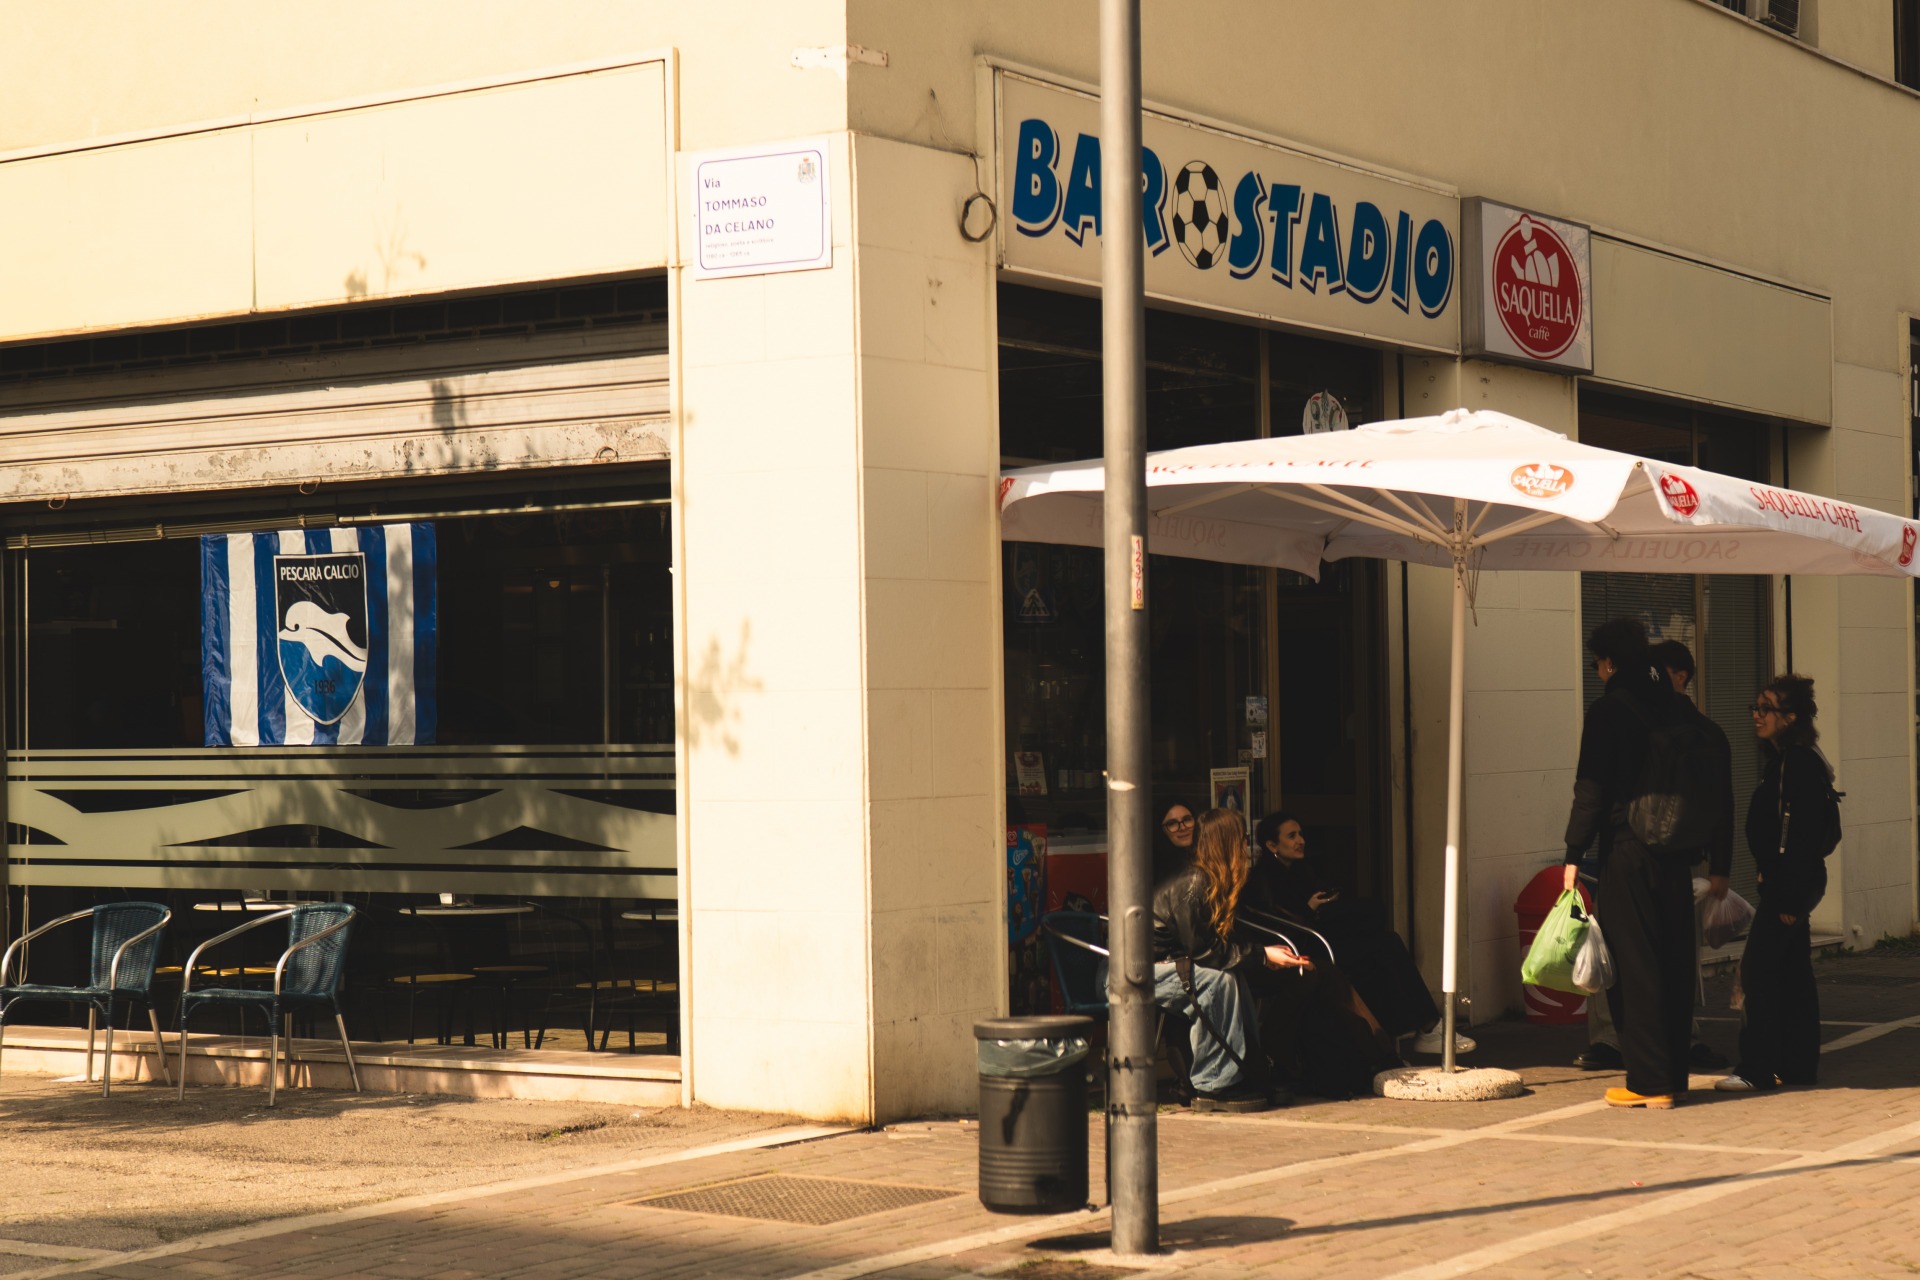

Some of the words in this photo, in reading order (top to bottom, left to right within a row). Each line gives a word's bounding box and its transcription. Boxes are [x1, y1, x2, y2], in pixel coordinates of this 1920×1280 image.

[704, 178, 721, 189] Via
[705, 196, 767, 212] TOMMASO
[705, 223, 721, 235] DA
[725, 218, 775, 233] CELANO
[1229, 170, 1454, 319] STADIO
[1501, 282, 1575, 326] SAQUELLA
[1529, 325, 1550, 340] caffè
[1512, 475, 1566, 493] SAQUELLA
[1750, 487, 1826, 521] SAQUELLA
[280, 566, 322, 581] PESCARA
[324, 563, 359, 580] CALCIO
[1135, 538, 1143, 600] 12378
[313, 679, 336, 694] 1936
